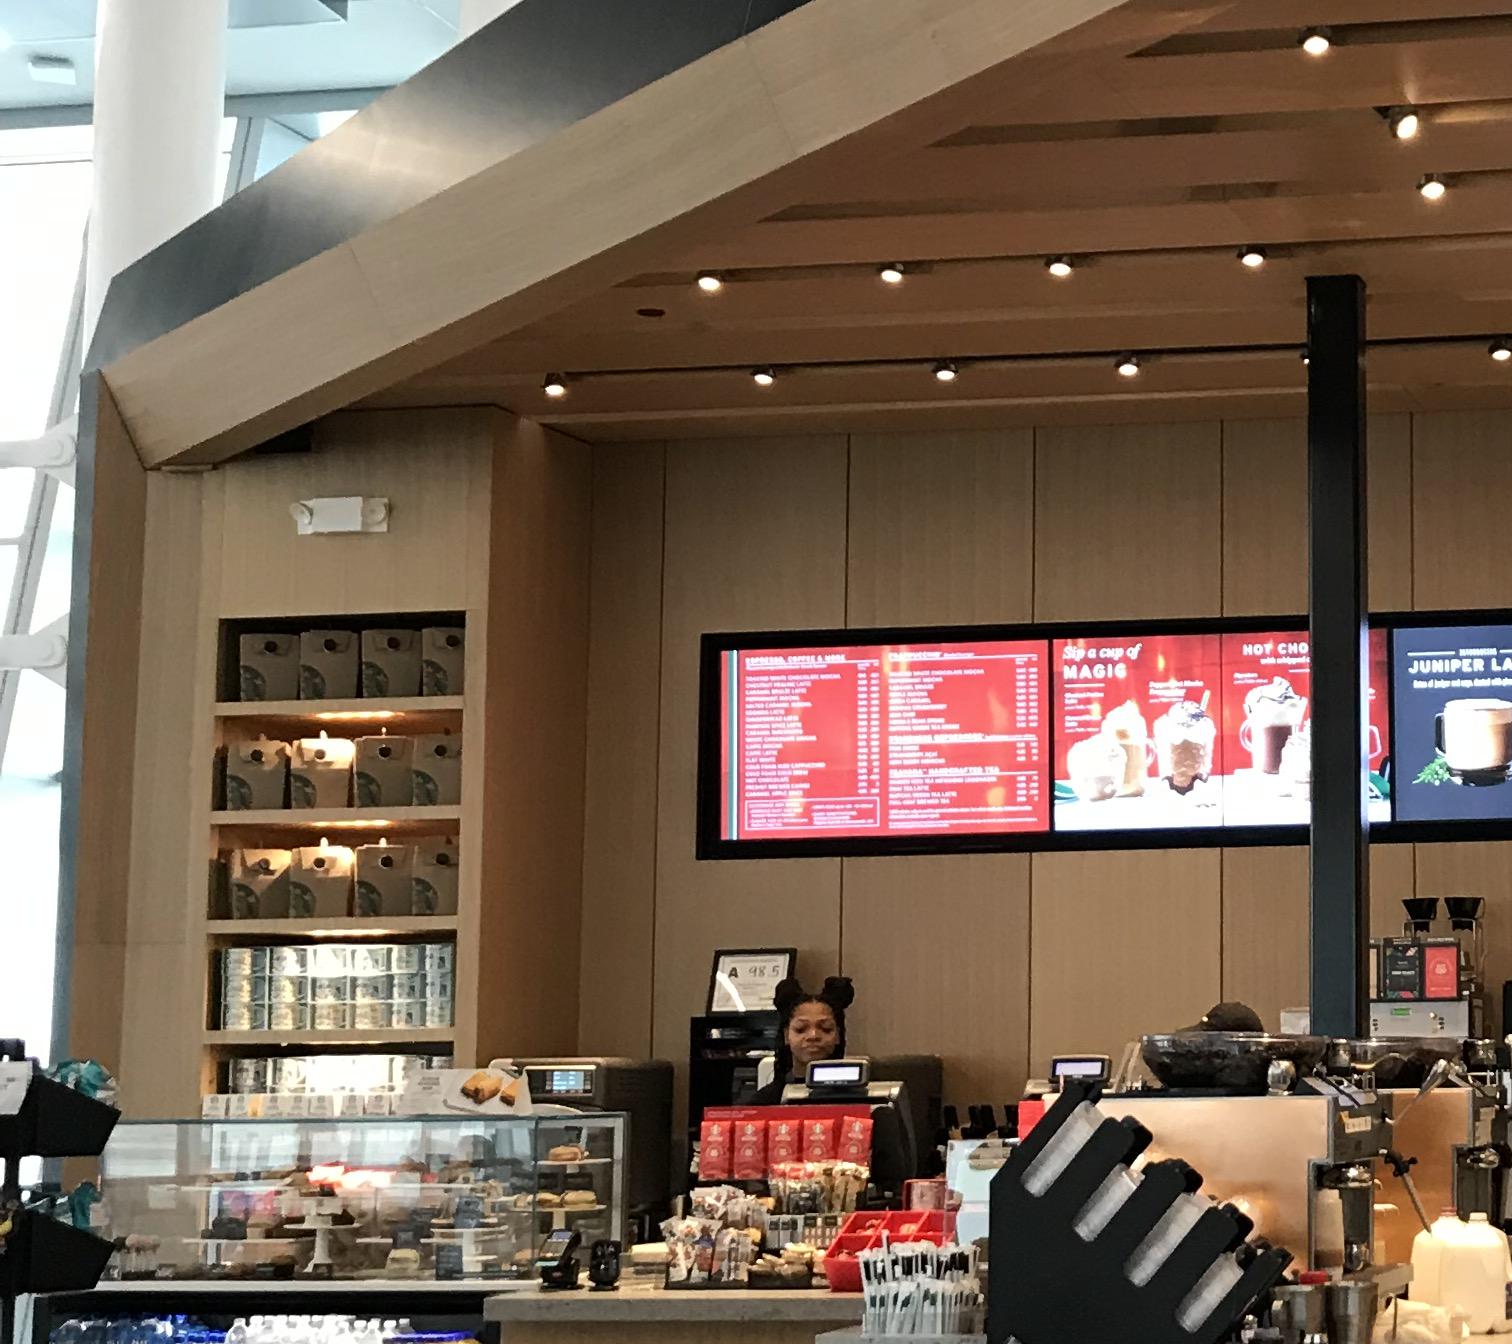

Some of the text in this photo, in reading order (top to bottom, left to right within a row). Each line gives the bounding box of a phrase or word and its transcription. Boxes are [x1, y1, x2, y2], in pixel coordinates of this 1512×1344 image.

[1062, 642, 1143, 662] Sip a cup of
[1242, 642, 1273, 656] HOT
[1063, 662, 1128, 680] MAGIC
[1407, 658, 1485, 674] JUNIPER
[728, 966, 739, 978] A
